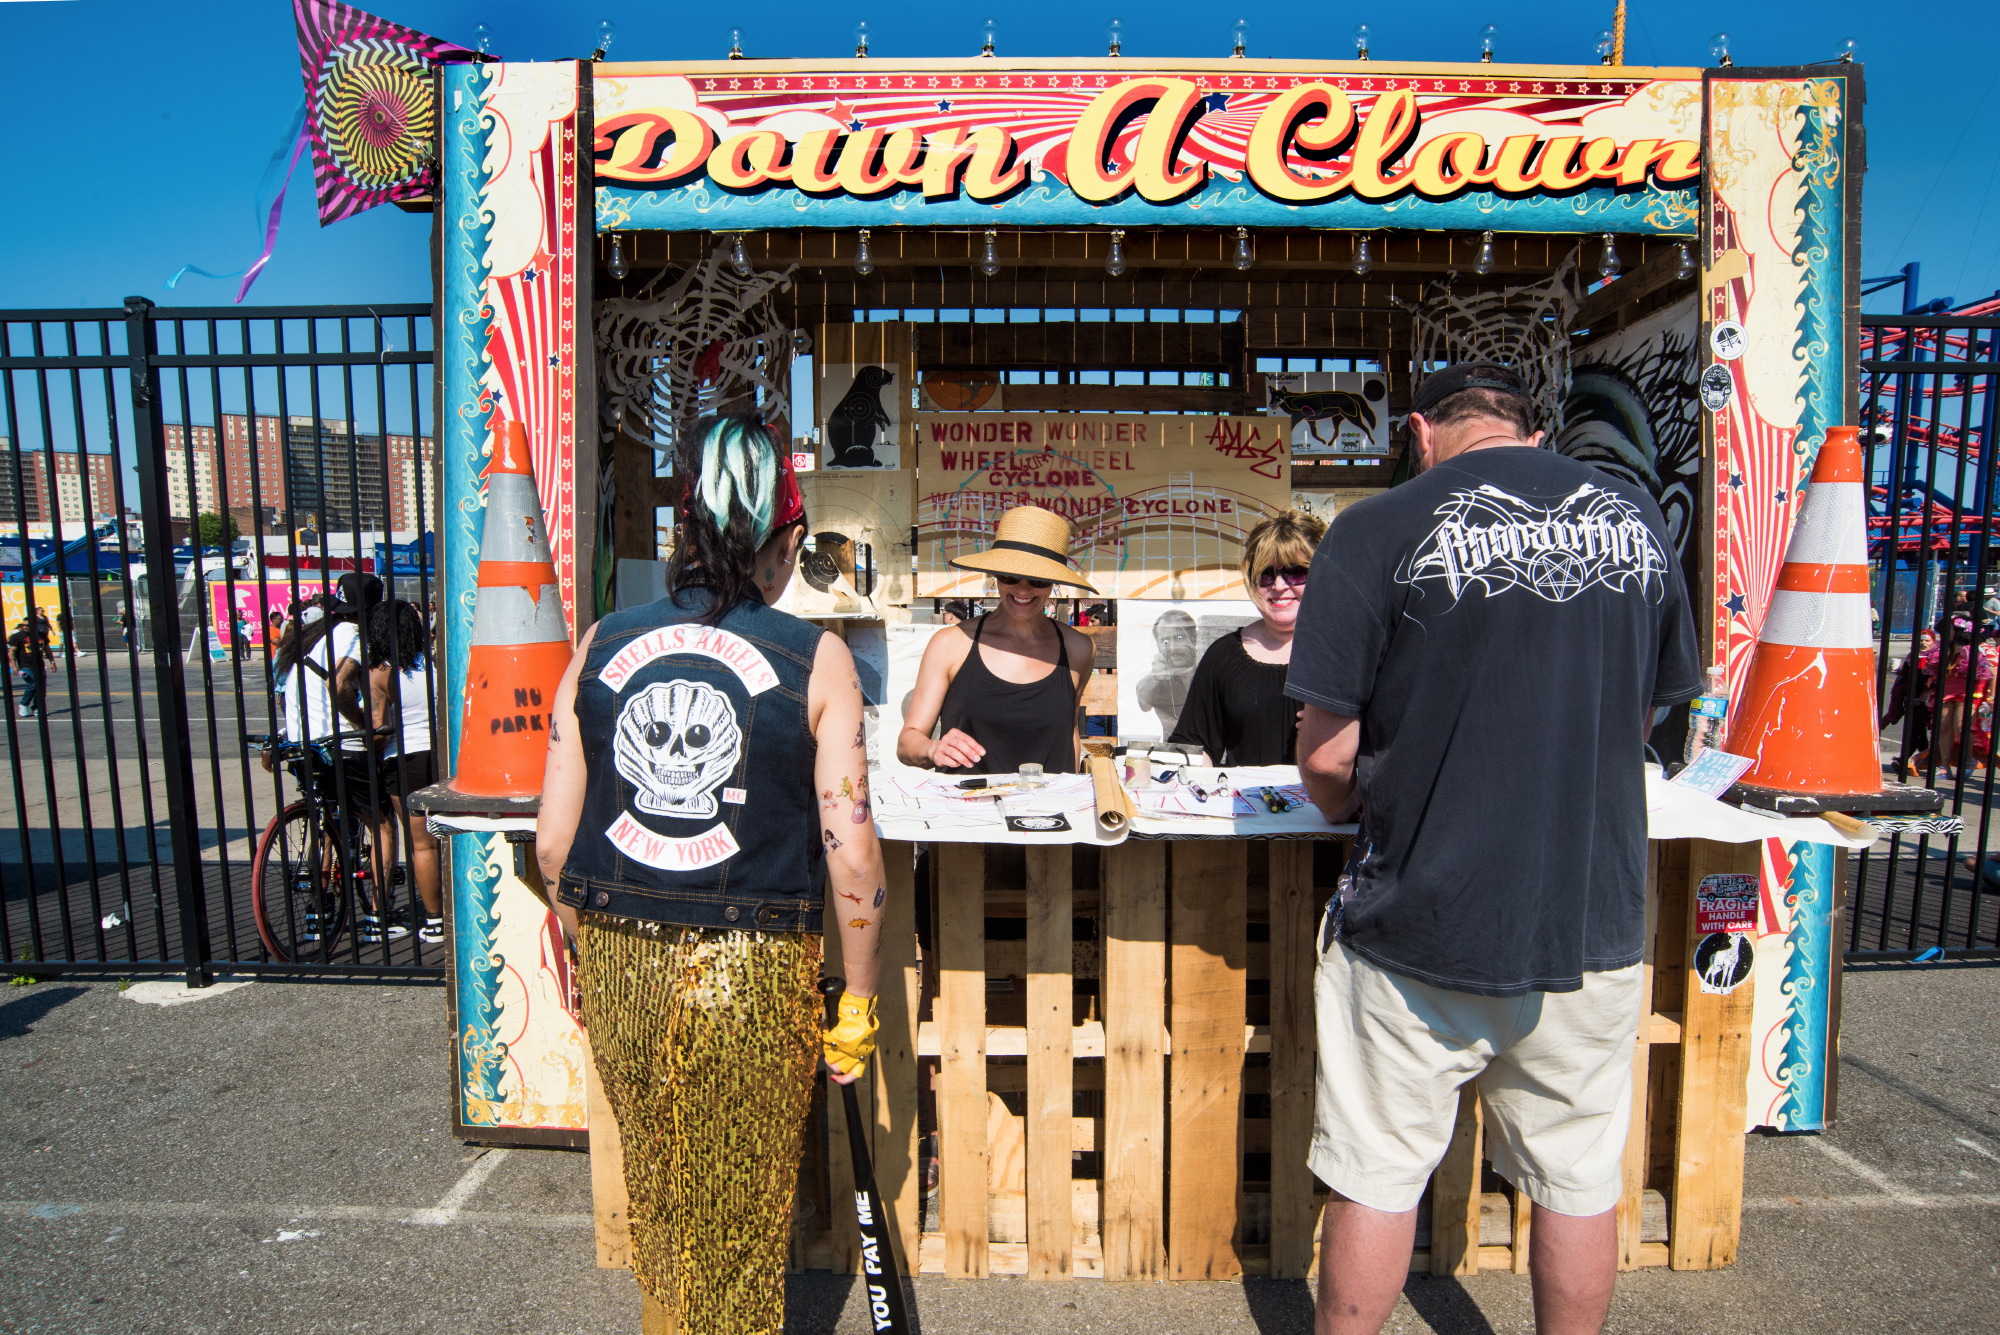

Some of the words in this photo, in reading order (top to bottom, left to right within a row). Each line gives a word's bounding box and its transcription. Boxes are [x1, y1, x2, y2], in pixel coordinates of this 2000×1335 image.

[593, 106, 1031, 204] Down
[1066, 77, 1208, 204] A
[1245, 81, 1700, 206] Clown
[931, 421, 1032, 443] WONDER
[1047, 421, 1147, 442] WONDER
[941, 451, 1022, 471] WHEEL
[1058, 450, 1136, 471] WHEEL
[989, 470, 1096, 488] CYCLONE
[1127, 499, 1232, 514] CYCLONE
[604, 628, 686, 688] SHELLS
[693, 629, 774, 688] ANGELS
[514, 687, 542, 708] NO
[491, 713, 552, 736] PARK
[725, 789, 744, 802] MC
[611, 818, 665, 864] NEW
[675, 831, 734, 866] YORK
[1699, 899, 1756, 912] FRAGILE
[1708, 911, 1746, 921] HANDLE
[1702, 922, 1725, 931] WITH
[1727, 921, 1753, 930] CARE
[854, 1190, 874, 1227] ME
[860, 1230, 883, 1276] PAY
[868, 1285, 892, 1332] YOU
